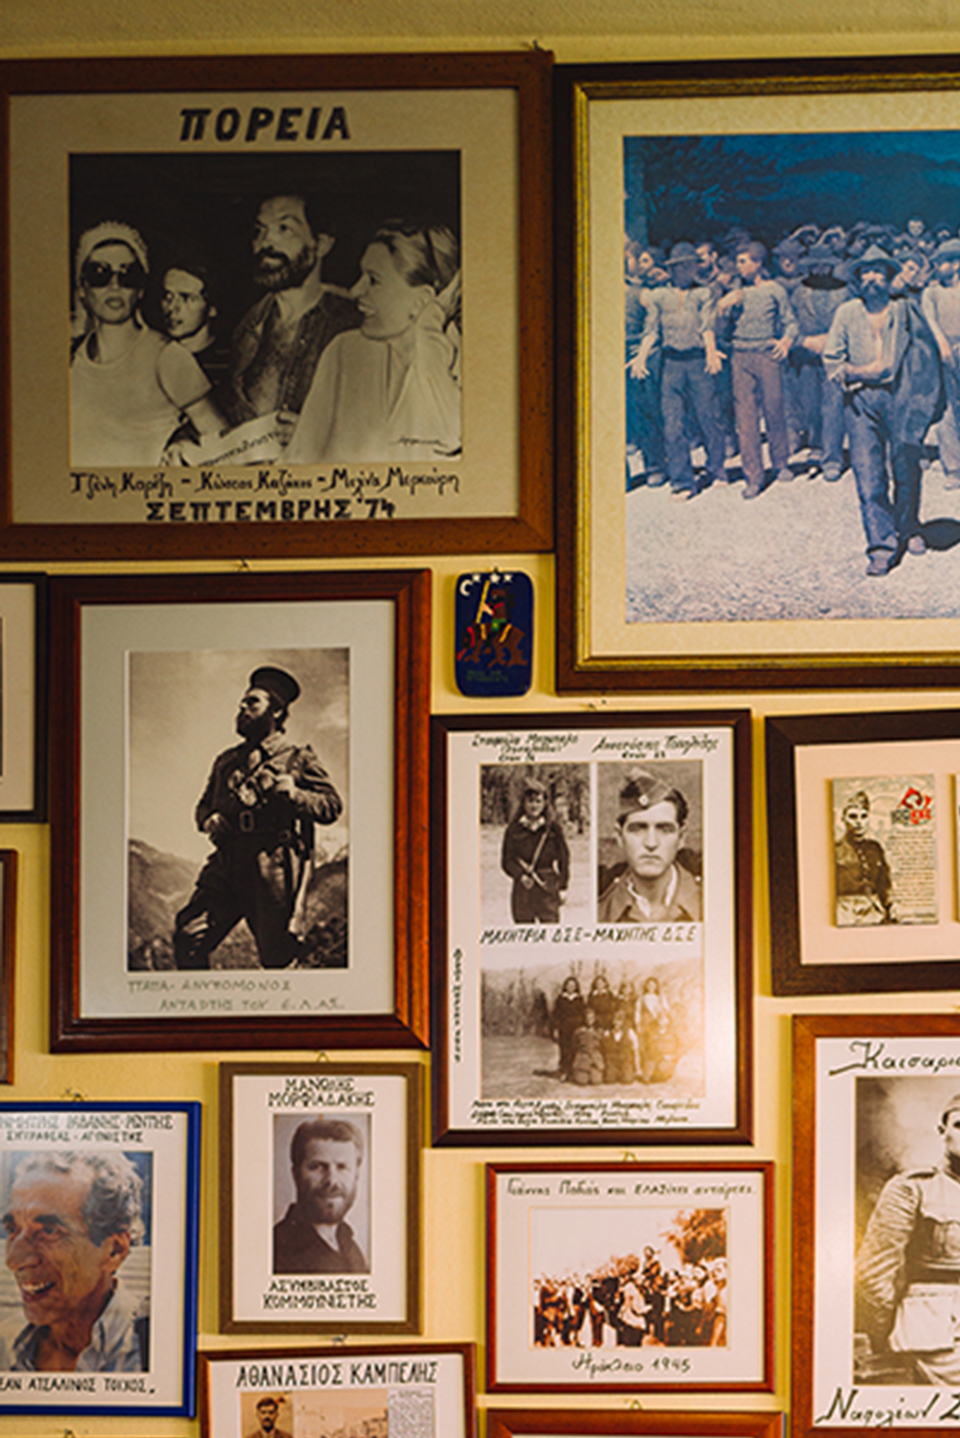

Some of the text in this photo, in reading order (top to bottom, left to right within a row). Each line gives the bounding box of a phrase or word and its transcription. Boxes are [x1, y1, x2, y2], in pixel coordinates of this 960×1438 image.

[179, 105, 352, 143] ΠΟΡΕΙΑ
[146, 500, 353, 522] ΣΕΠΤΕΜΒΡΗΣ
[480, 926, 546, 944] ΜΑΧΗΤΡΙΑ
[236, 1363, 344, 1388] ΑΘΑΝΑΣΙΟΣ
